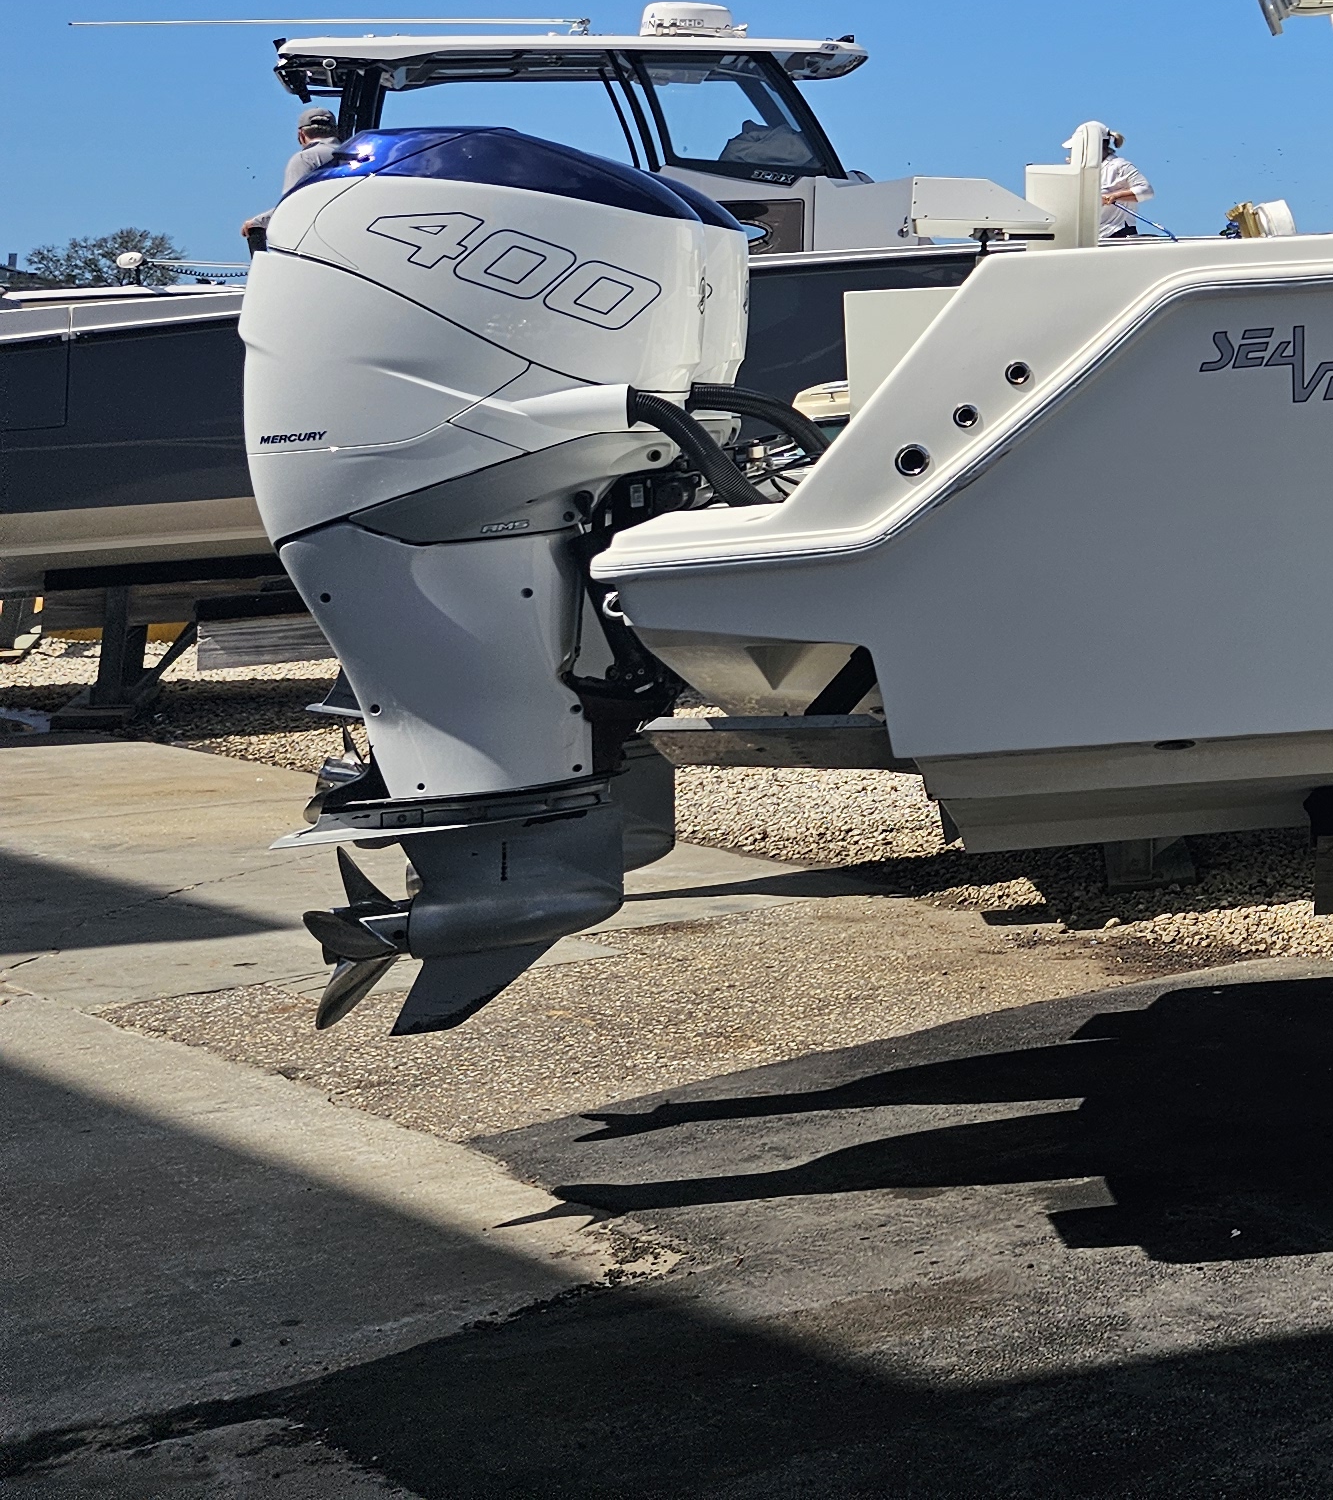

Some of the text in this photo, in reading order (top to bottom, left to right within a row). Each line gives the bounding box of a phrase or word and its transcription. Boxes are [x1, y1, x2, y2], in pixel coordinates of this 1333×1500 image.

[366, 212, 662, 330] 400
[259, 430, 327, 445] MERCURY
[480, 519, 529, 533] AMS
